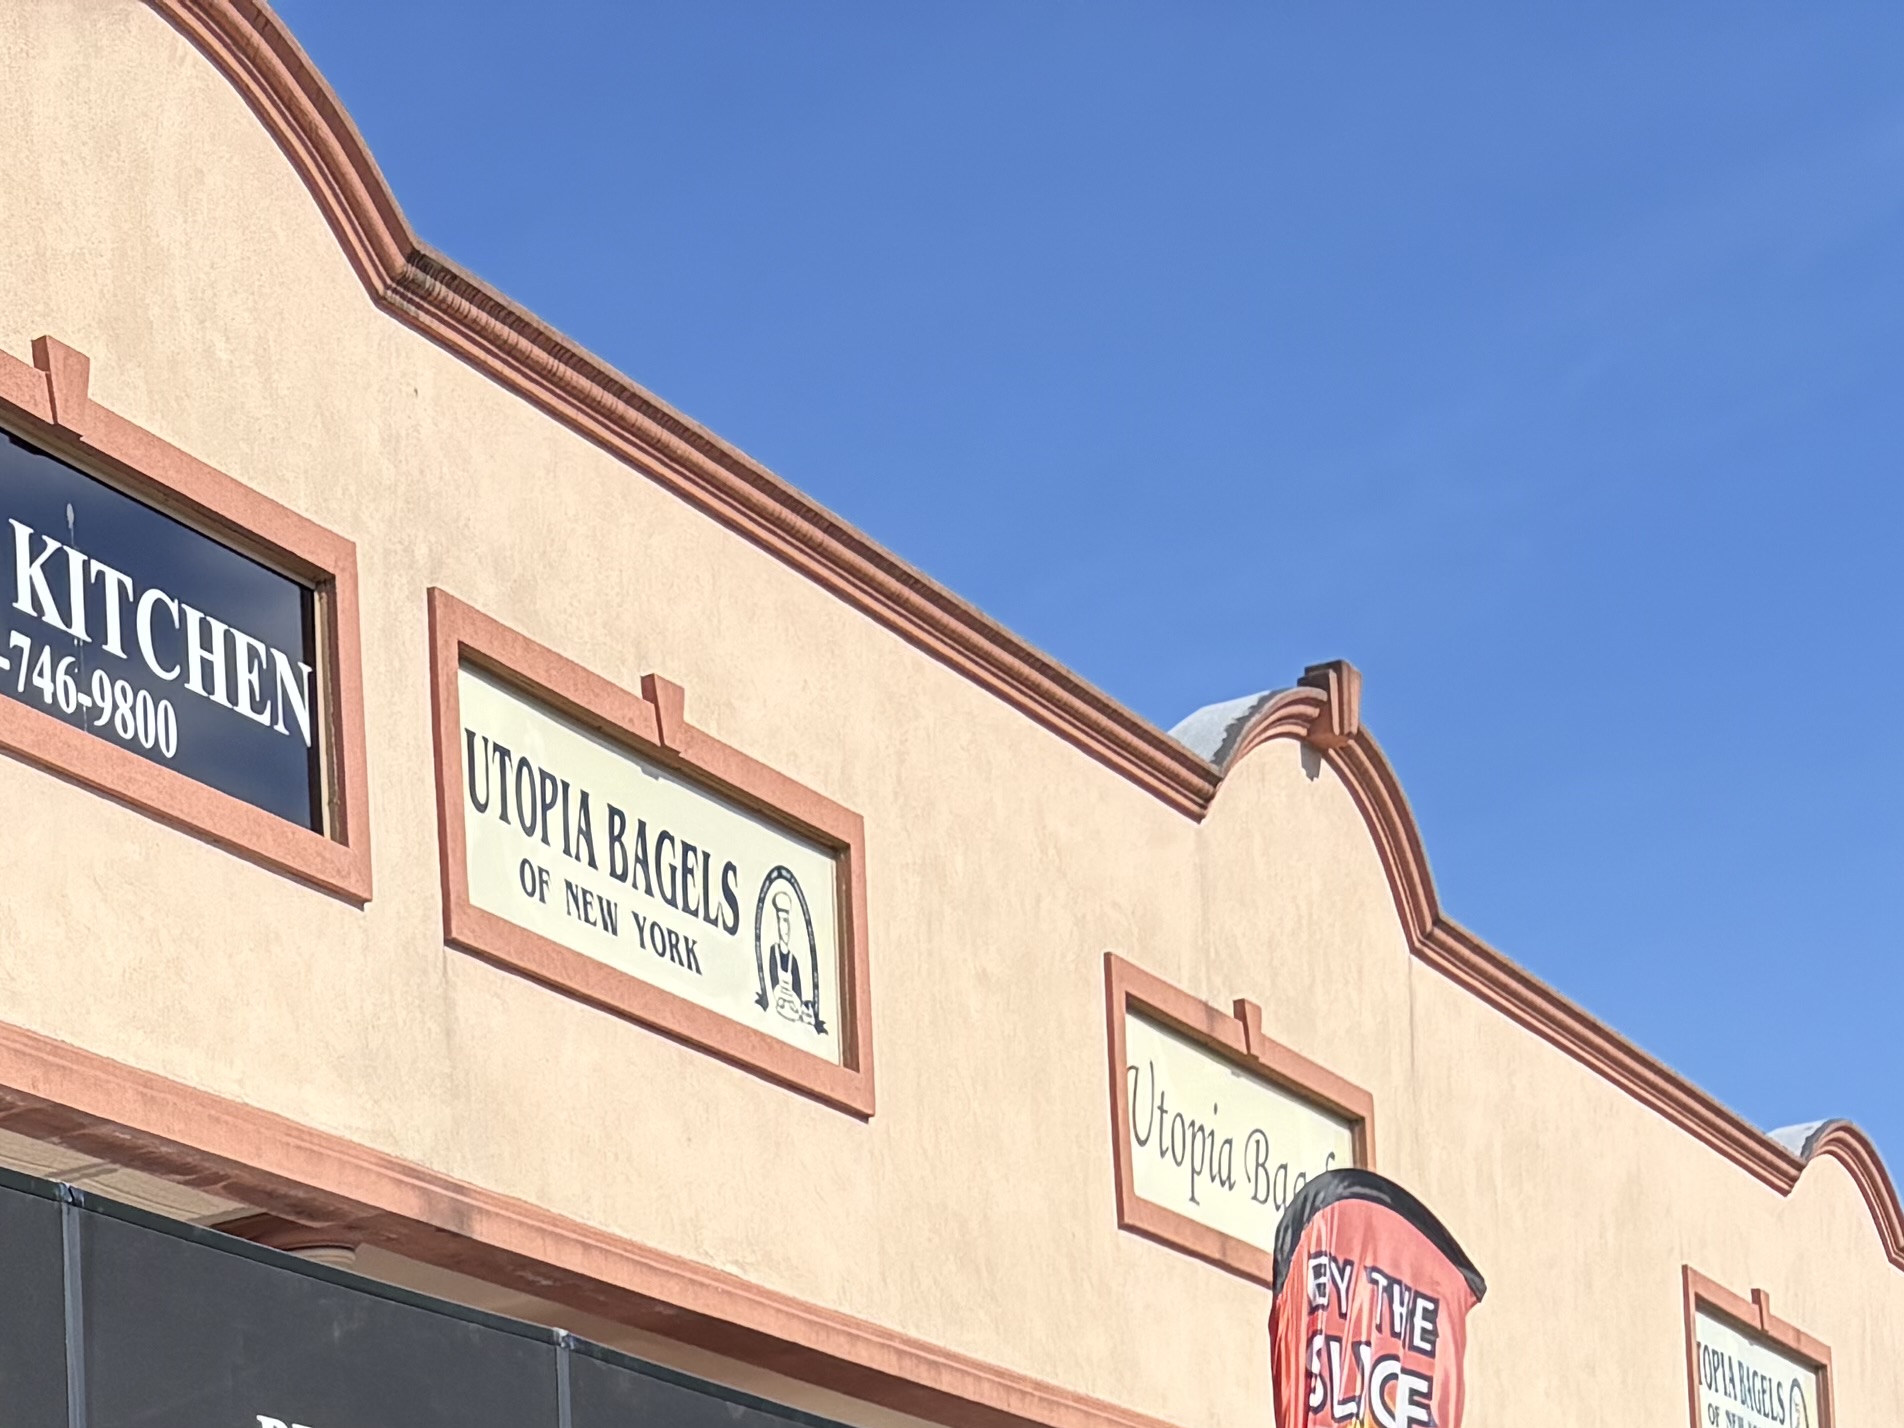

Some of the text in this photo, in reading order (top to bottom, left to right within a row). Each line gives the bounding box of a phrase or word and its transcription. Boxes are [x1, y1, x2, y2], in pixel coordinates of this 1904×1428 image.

[8, 518, 313, 748] KITCHEN
[464, 727, 740, 937] UTOPIA BAGELS
[519, 857, 703, 976] OF NEW YORK
[1126, 1059, 1236, 1206] Utopia
[1307, 1250, 1440, 1358] BY THE
[1697, 1341, 1786, 1426] TOPIA BAGELS
